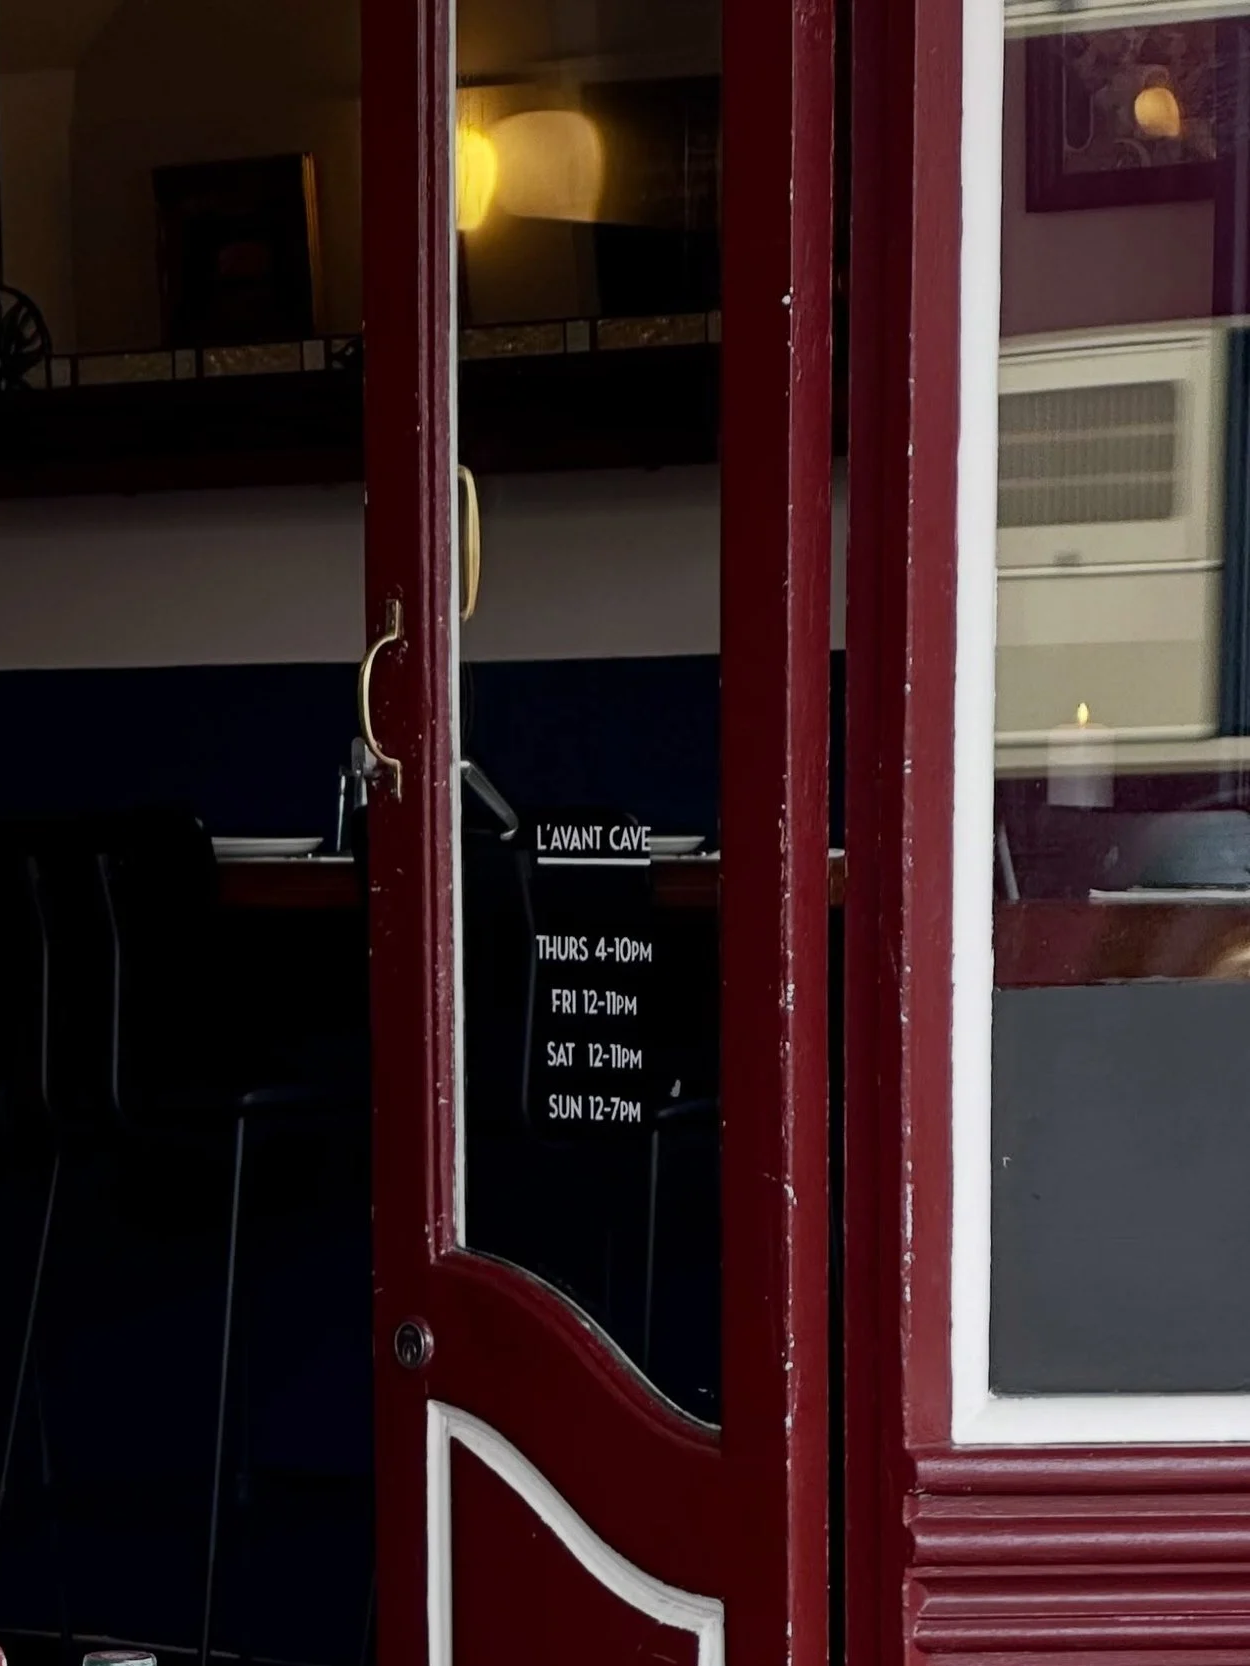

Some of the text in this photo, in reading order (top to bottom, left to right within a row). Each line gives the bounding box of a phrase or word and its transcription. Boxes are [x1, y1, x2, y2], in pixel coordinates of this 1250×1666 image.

[537, 823, 652, 852] L'AVANT CAVE
[536, 935, 653, 963] THURS 4-10PM
[551, 988, 638, 1016] FRI 12-11PM
[547, 1040, 643, 1070] SAT 12-11PM
[548, 1093, 642, 1123] SUN 12-7PM
